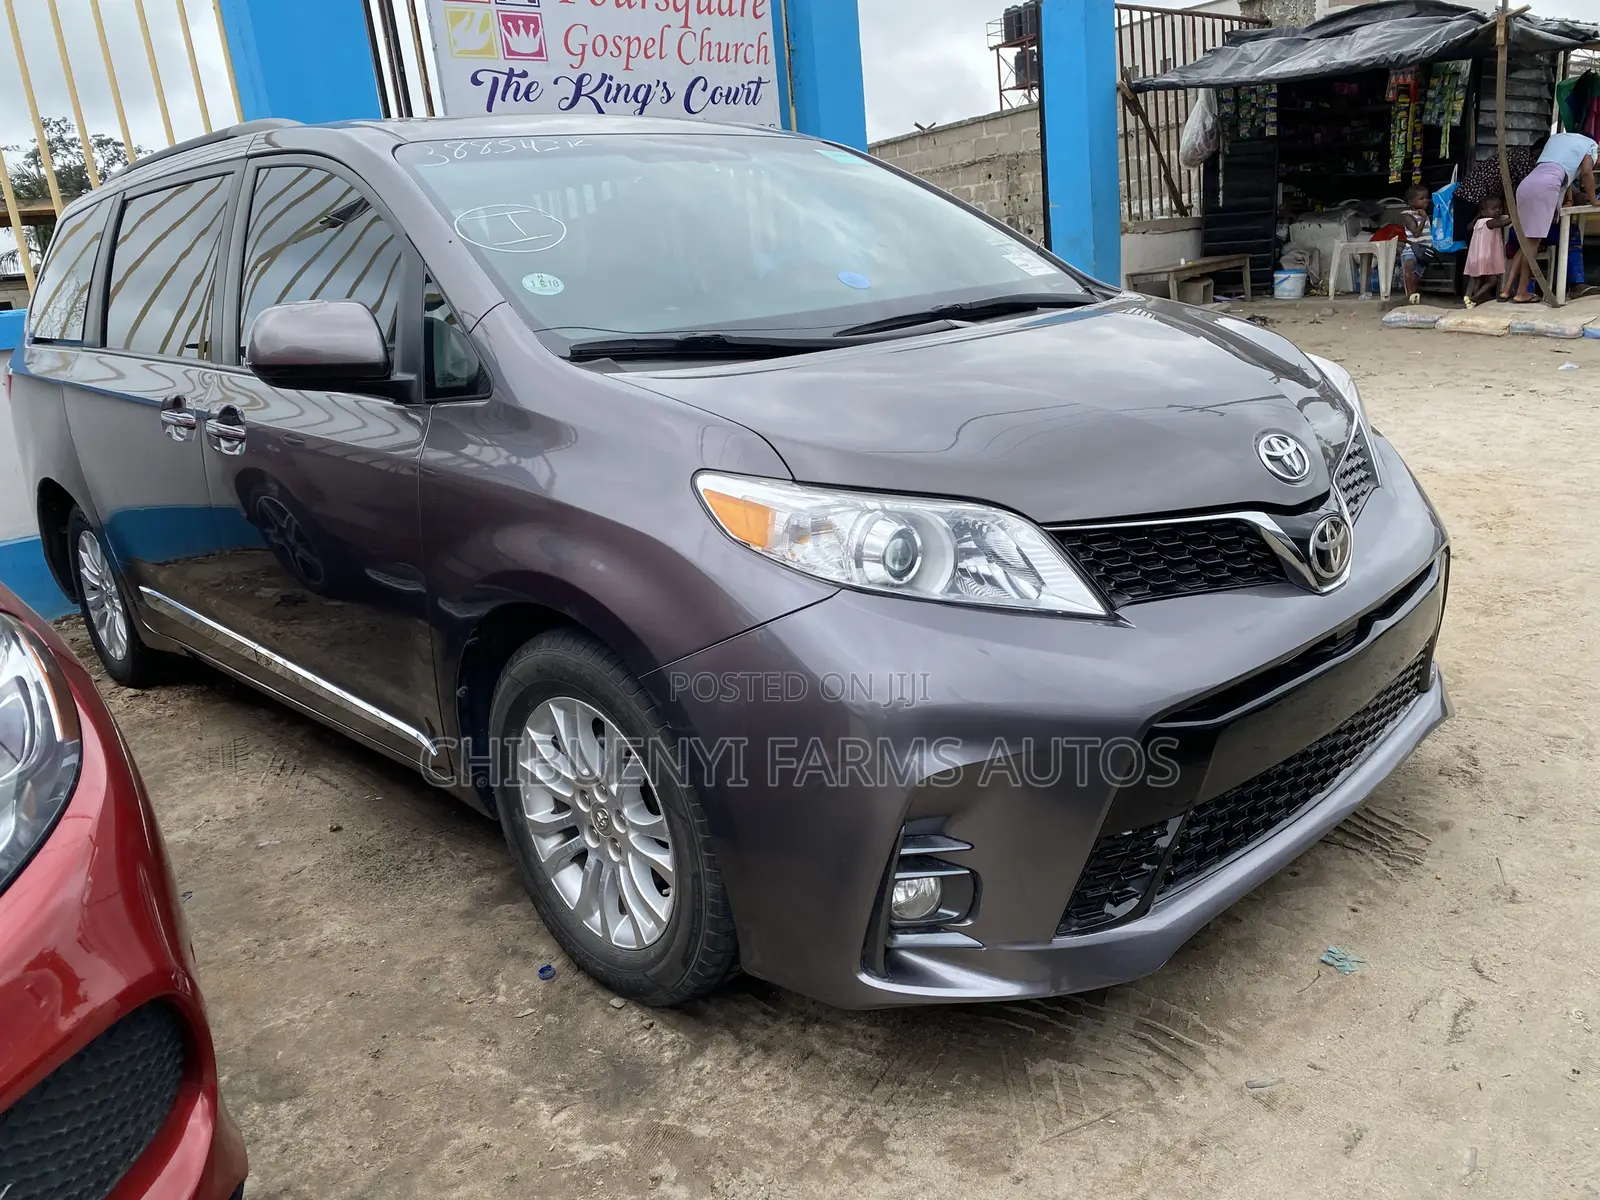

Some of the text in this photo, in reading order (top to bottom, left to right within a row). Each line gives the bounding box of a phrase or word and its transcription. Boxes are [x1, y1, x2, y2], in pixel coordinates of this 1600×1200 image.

[559, 0, 765, 29] quare
[563, 23, 770, 70] Gospel Church
[470, 67, 770, 115] The King's Court
